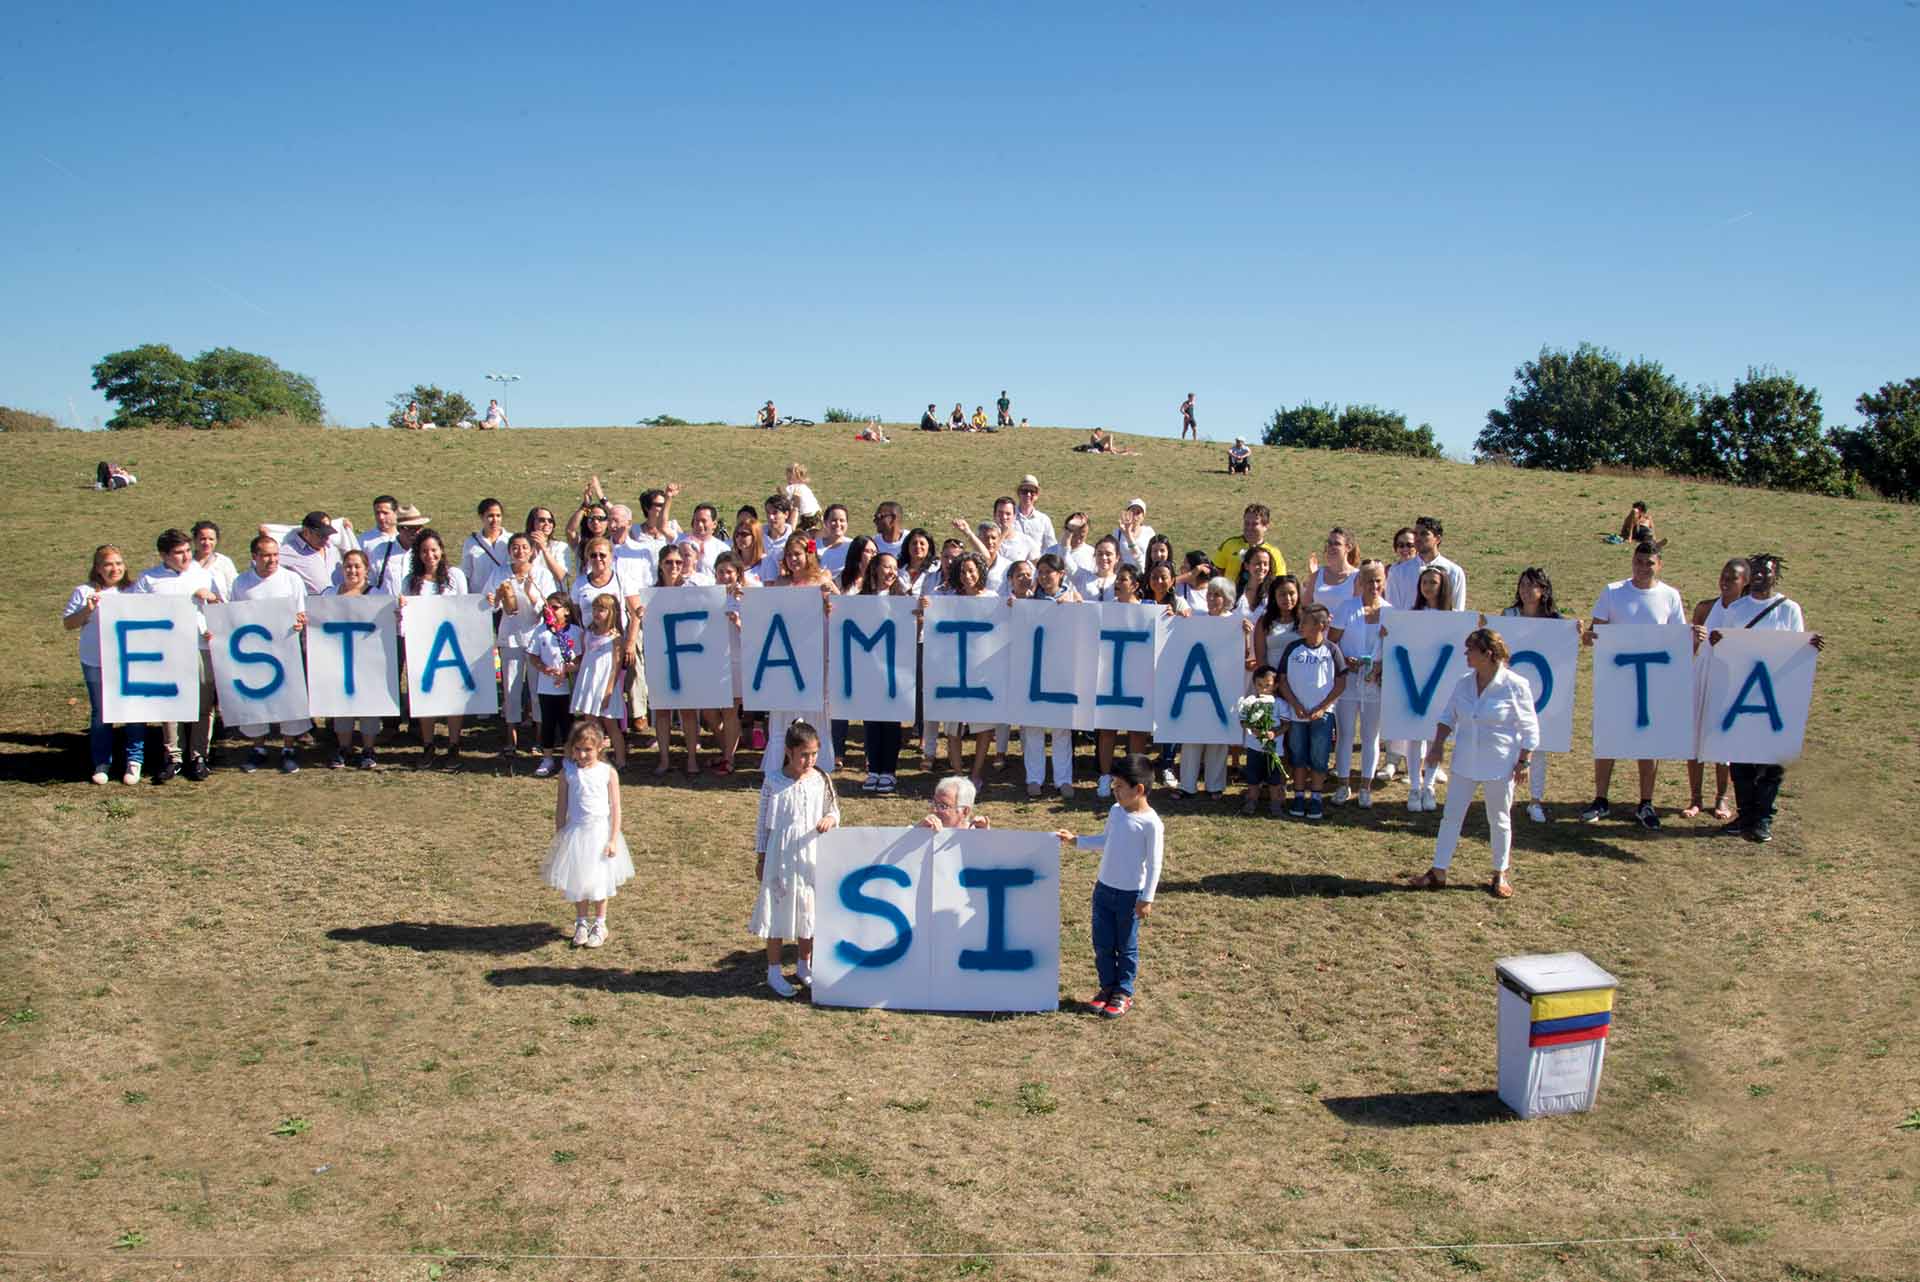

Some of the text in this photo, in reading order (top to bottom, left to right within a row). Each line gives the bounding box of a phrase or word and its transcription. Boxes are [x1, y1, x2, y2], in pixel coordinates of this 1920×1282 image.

[115, 610, 1785, 734] ESTA FAMILIA VOTA
[834, 863, 1038, 973] SI
